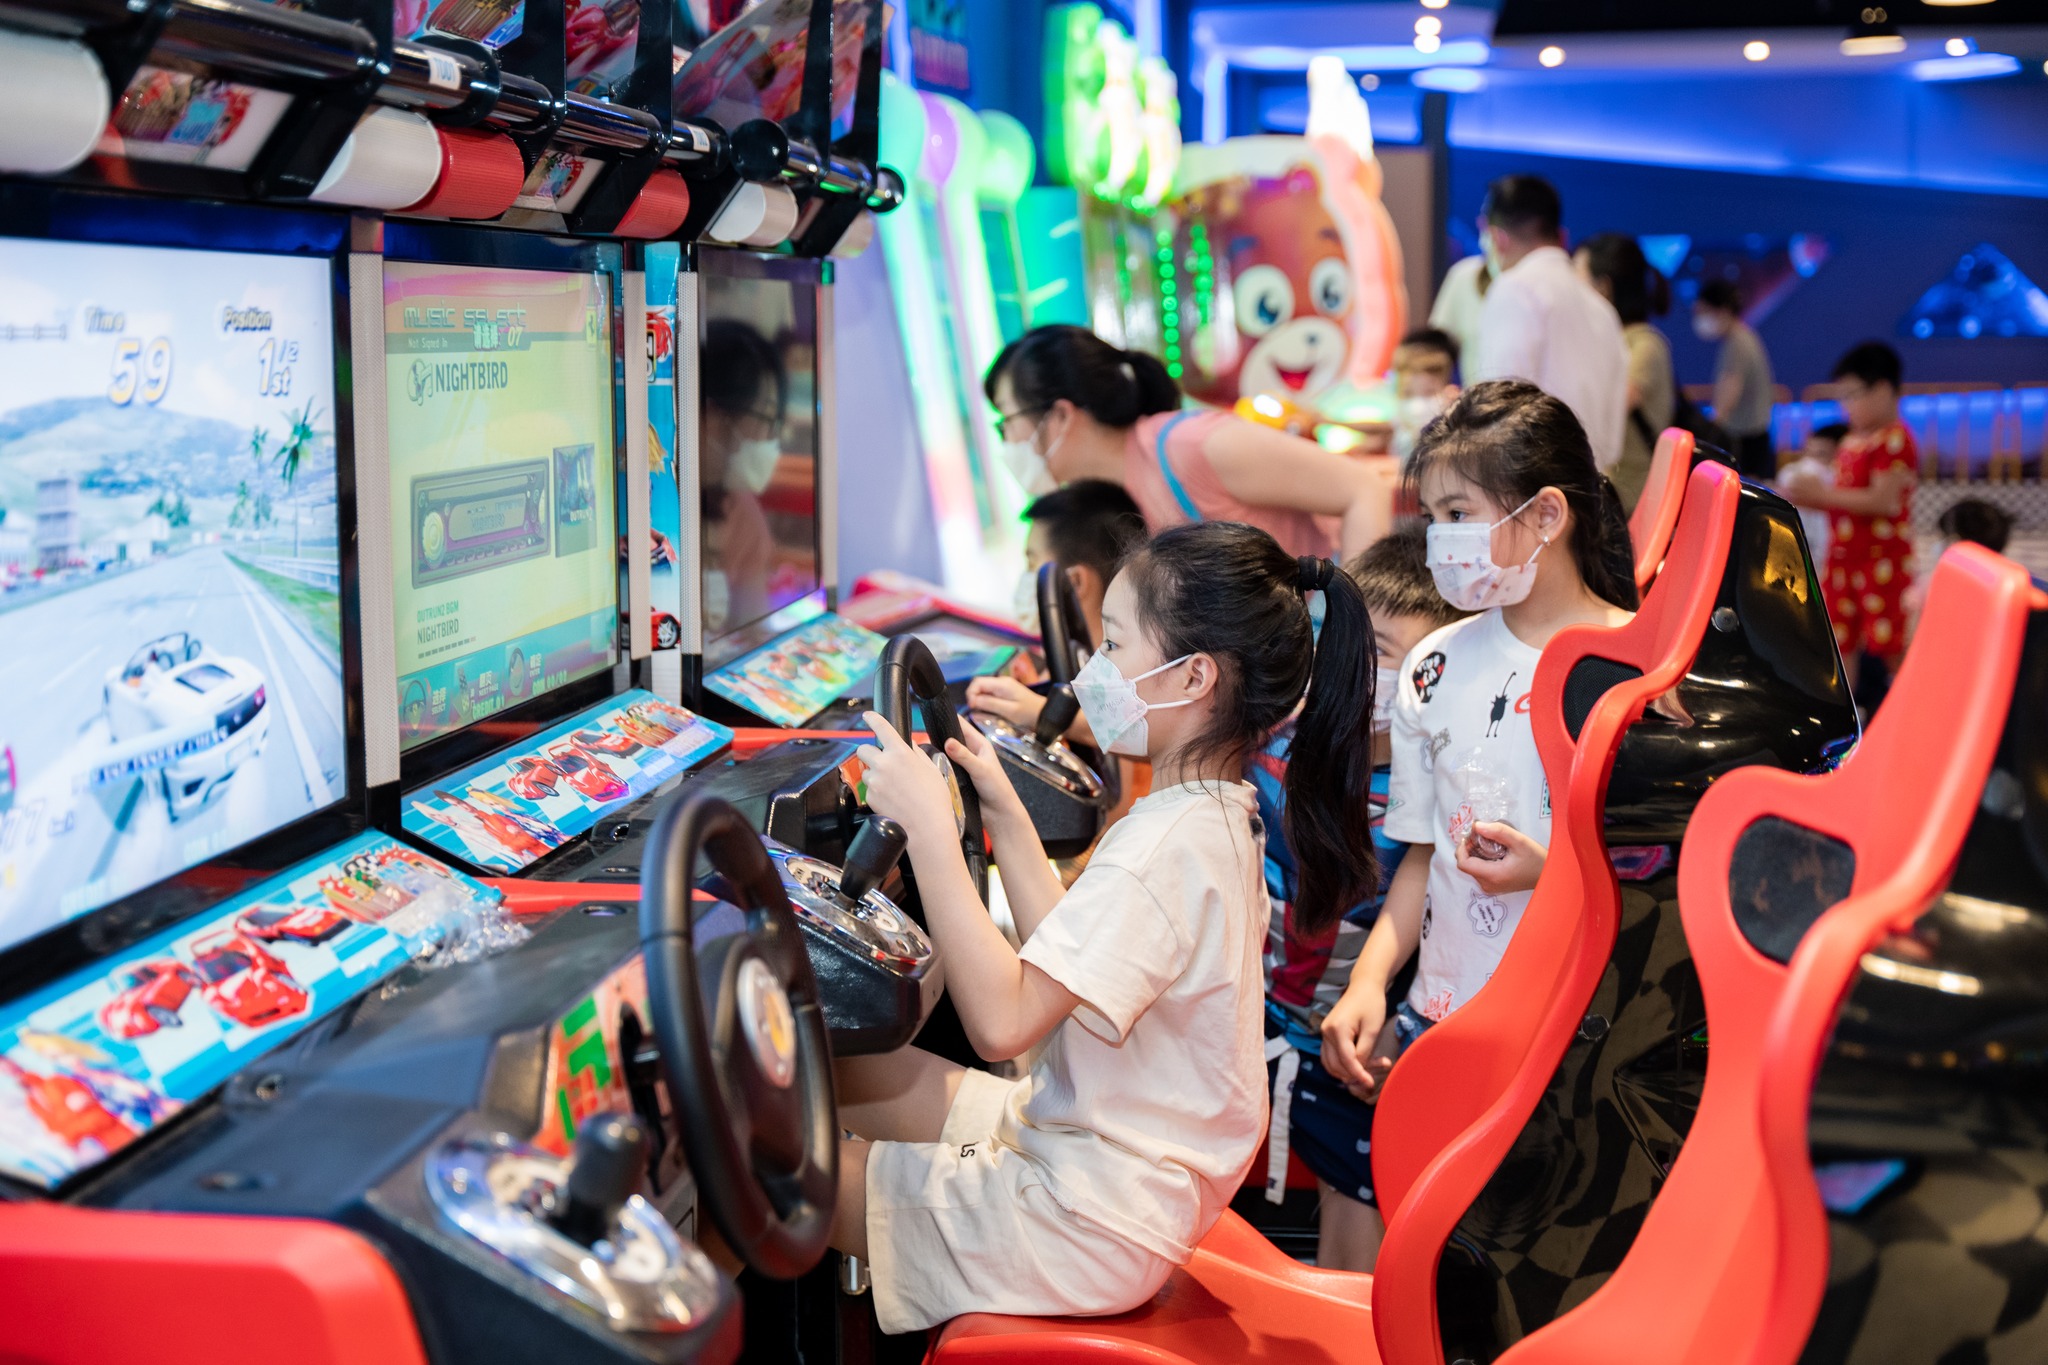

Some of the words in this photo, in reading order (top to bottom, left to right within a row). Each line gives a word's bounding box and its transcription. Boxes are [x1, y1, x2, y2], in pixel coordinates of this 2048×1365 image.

[84, 306, 125, 333] Time
[223, 306, 273, 332] Position
[507, 325, 524, 348] 07
[107, 337, 172, 407] 59
[435, 361, 508, 393] NIGHTBIRD
[416, 604, 445, 624] OUTRUN2
[445, 599, 459, 615] BGM
[417, 618, 459, 645] NIGHTBIRD
